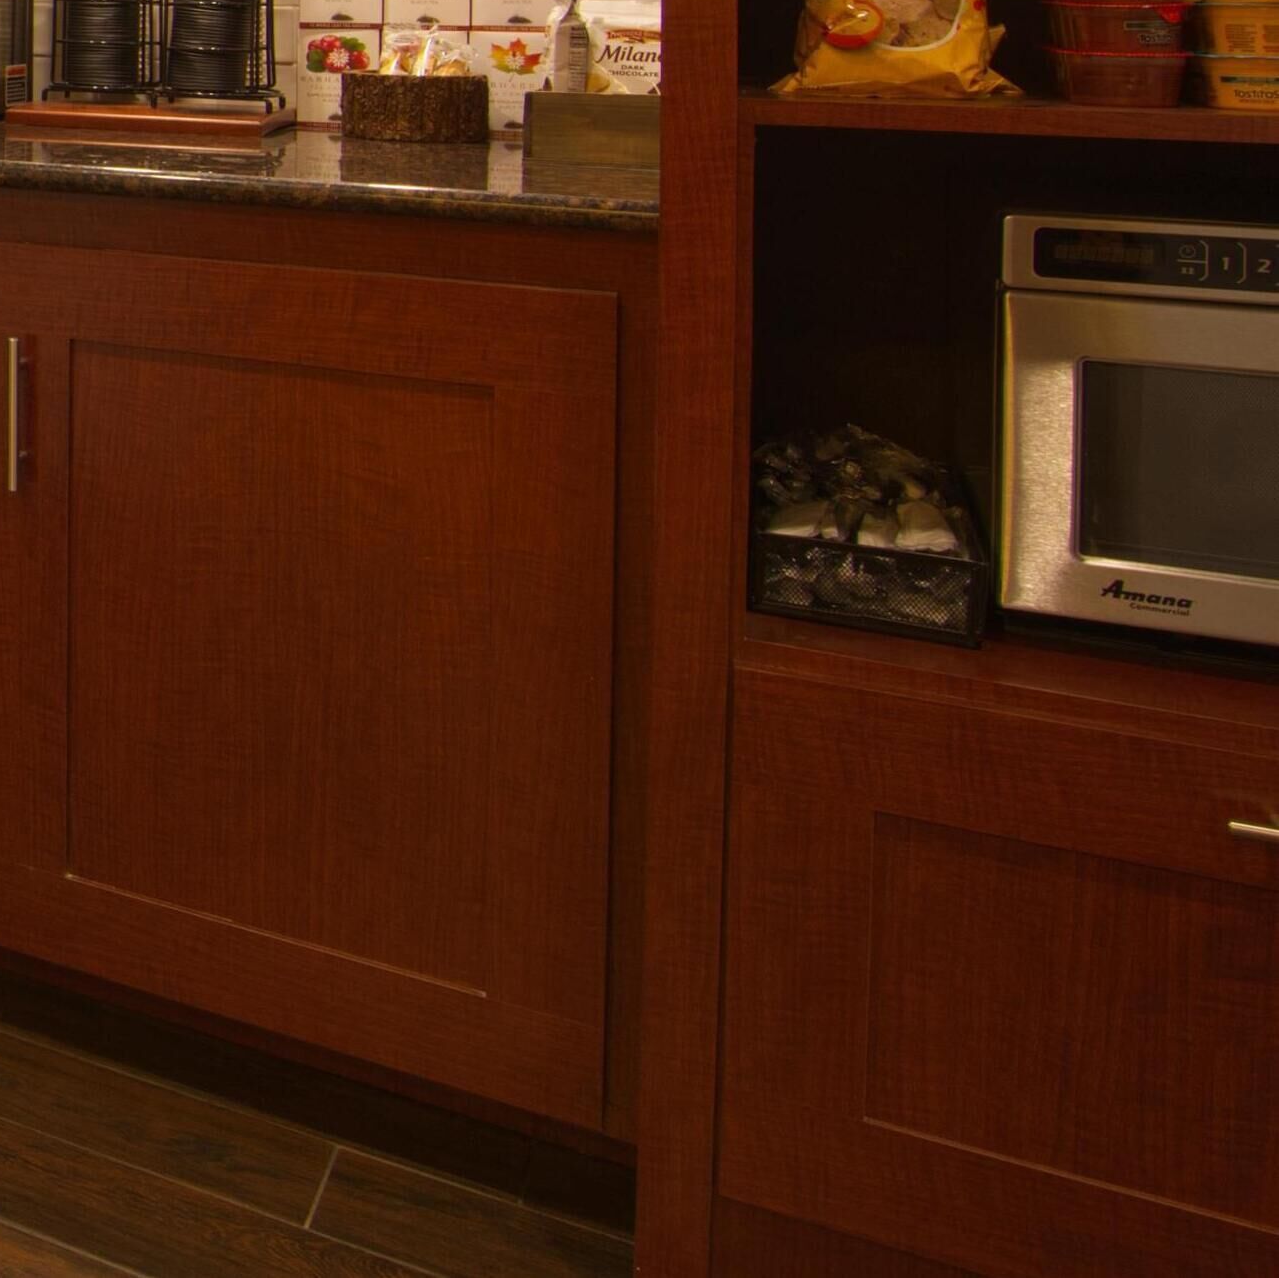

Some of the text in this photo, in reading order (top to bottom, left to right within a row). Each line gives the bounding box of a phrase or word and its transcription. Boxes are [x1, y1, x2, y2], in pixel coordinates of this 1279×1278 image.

[595, 43, 661, 64] Milan
[1221, 257, 1272, 274] 1 2
[1100, 579, 1194, 609] Amana
[1130, 602, 1190, 616] Commercial
